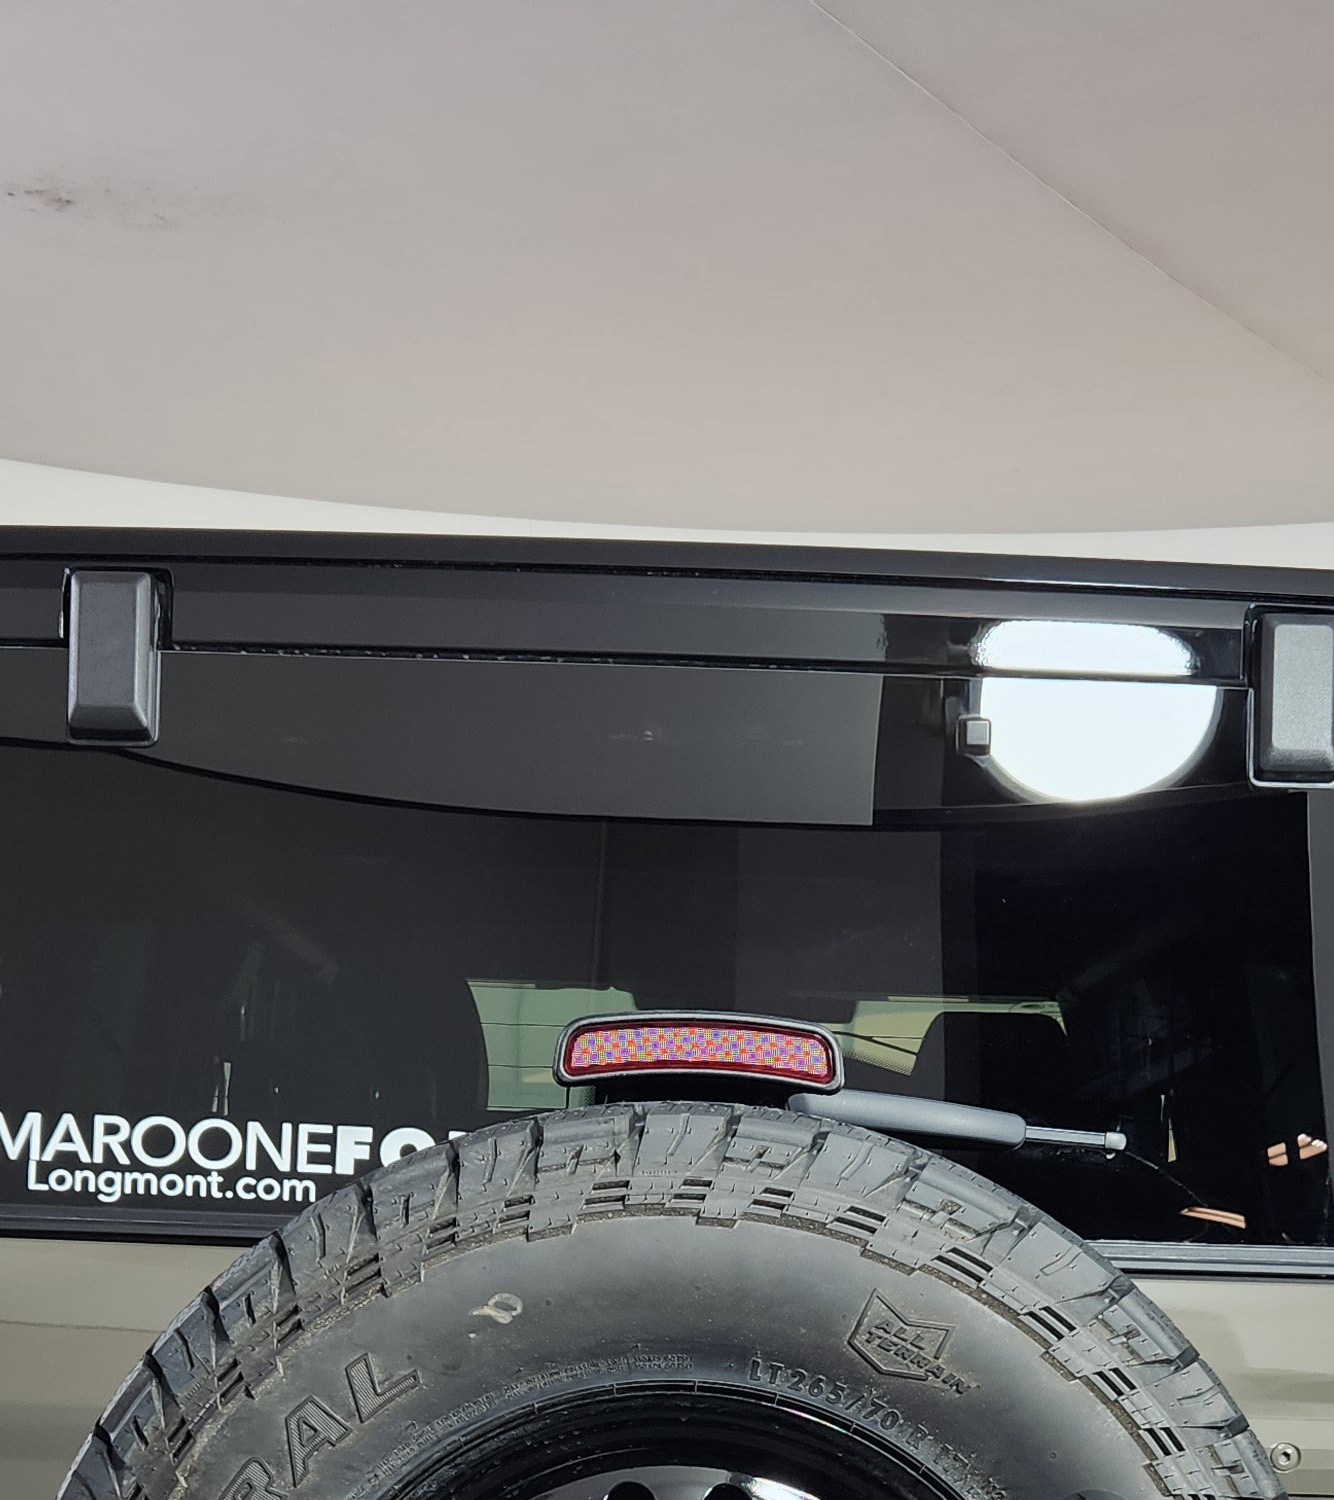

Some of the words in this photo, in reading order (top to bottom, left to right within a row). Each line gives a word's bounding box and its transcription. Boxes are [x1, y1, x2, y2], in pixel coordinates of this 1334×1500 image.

[27, 1160, 317, 1203] Longmont.com
[874, 1318, 925, 1351] ALL
[864, 1330, 968, 1395] TERRAIN
